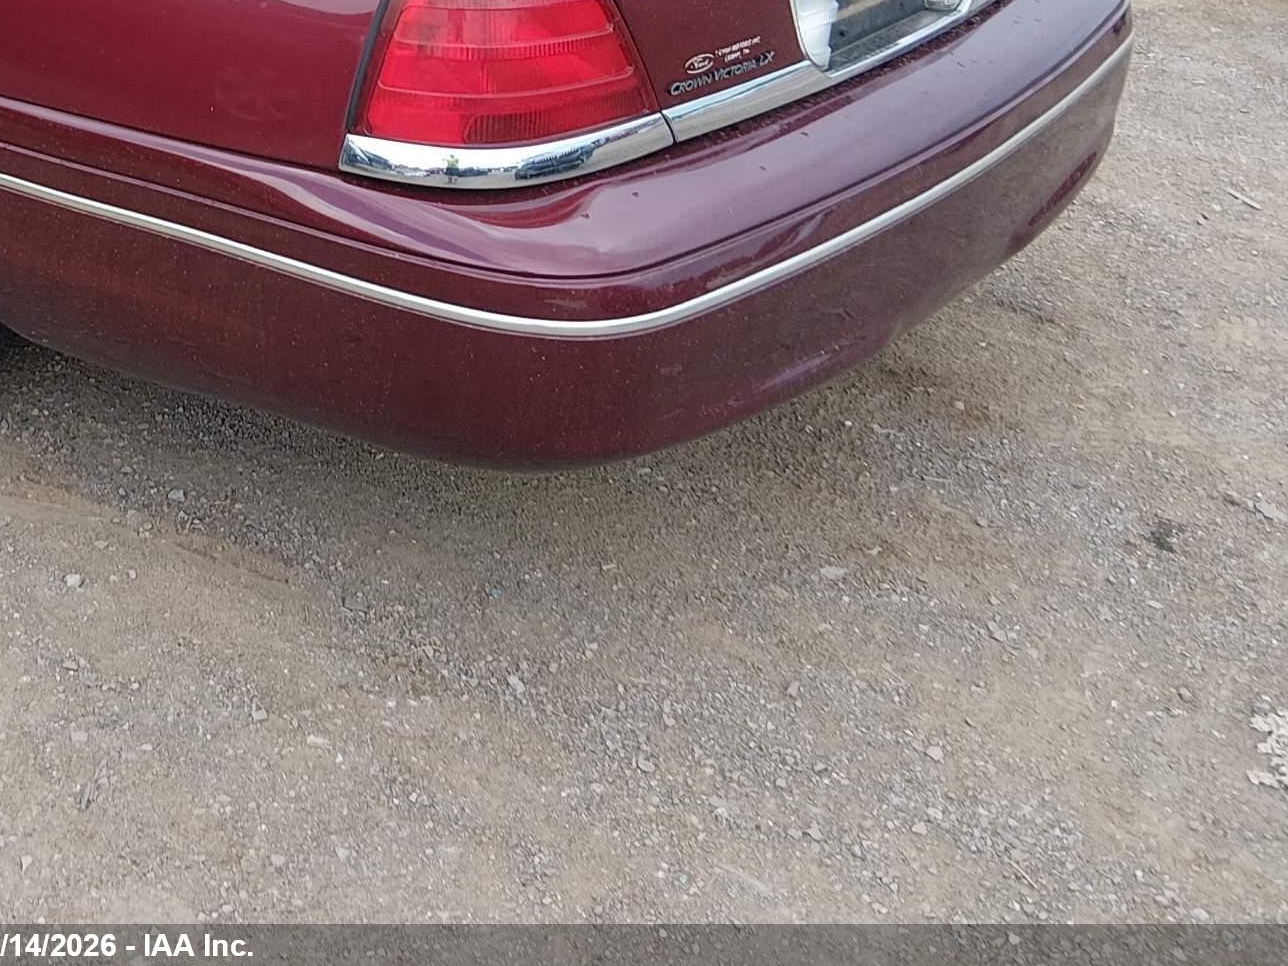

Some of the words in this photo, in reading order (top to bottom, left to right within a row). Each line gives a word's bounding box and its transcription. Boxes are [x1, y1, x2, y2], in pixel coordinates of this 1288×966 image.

[670, 73, 712, 95] CROWN
[714, 60, 757, 81] VICTORIA
[759, 51, 776, 67] LX
